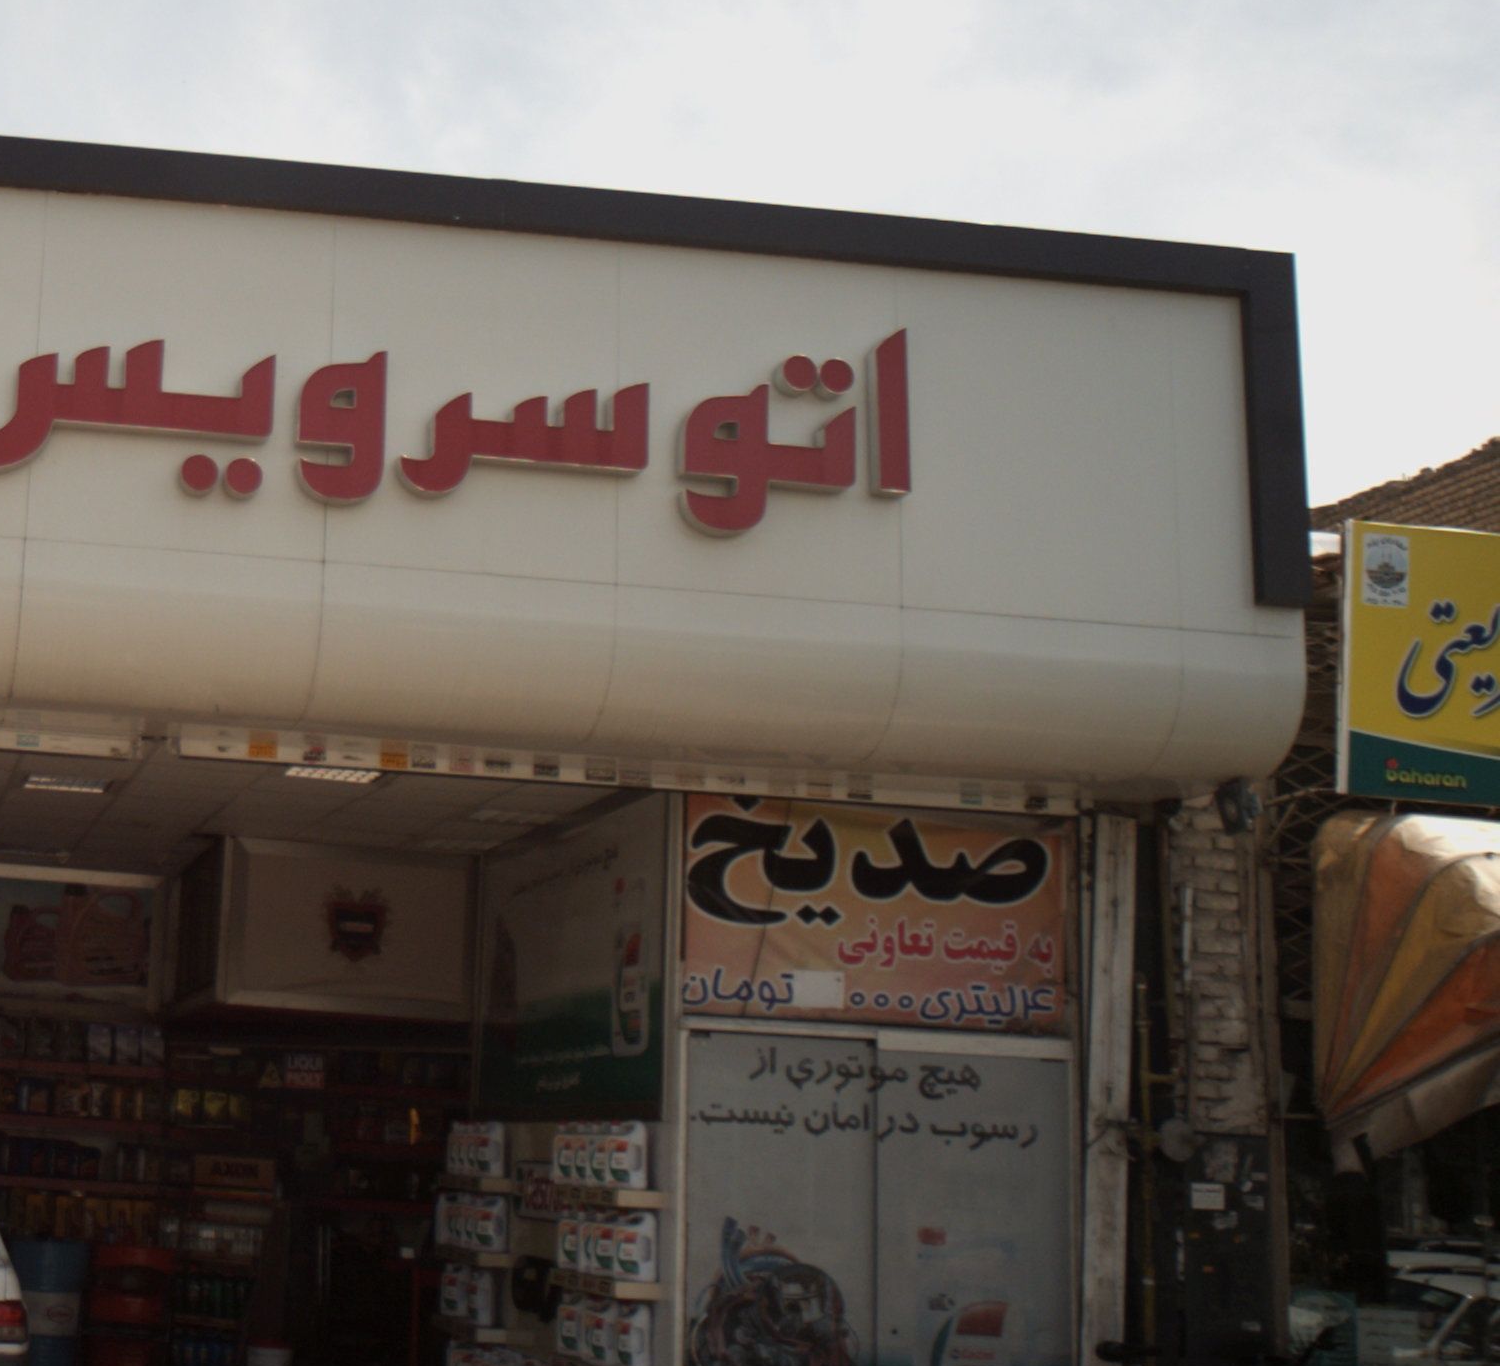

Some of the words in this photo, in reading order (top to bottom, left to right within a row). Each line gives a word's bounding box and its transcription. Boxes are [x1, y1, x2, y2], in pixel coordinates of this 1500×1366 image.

[1385, 758, 1467, 789] baharan
[837, 916, 935, 968] تعاونی
[944, 921, 1018, 972] قیمت
[1026, 935, 1054, 975] به
[681, 967, 795, 1012] تومان
[750, 1046, 777, 1081] از
[785, 1054, 908, 1093] موتوری
[918, 1063, 981, 1100] هیچ
[804, 1101, 869, 1135] امان
[878, 1111, 920, 1142] در
[930, 1119, 1042, 1151] رسوب
